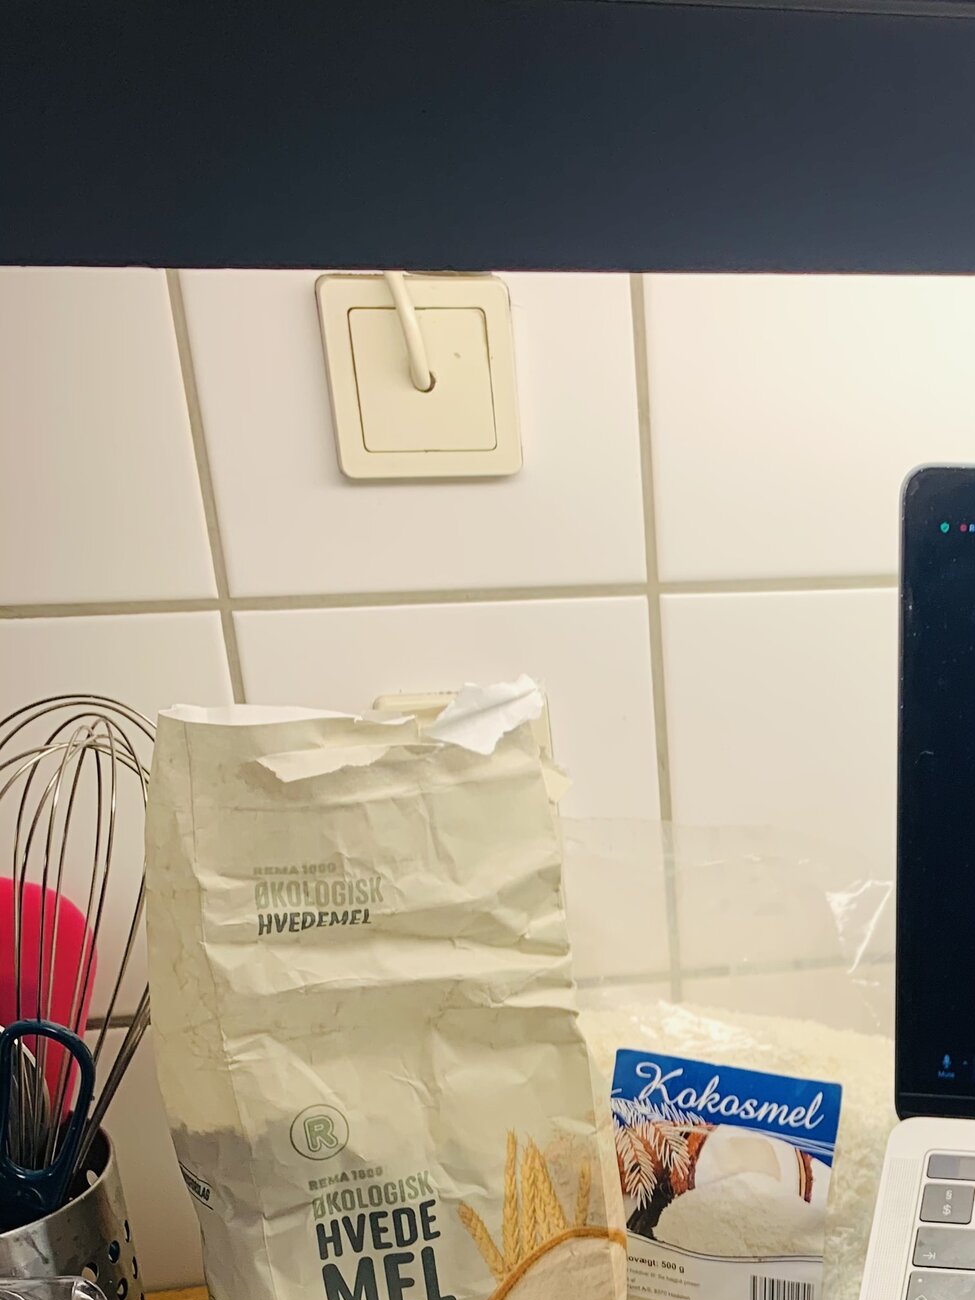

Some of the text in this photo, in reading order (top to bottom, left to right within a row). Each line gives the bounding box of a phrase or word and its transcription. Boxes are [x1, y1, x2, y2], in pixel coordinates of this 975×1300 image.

[253, 862, 337, 876] REMA 1000
[254, 876, 384, 910] ØKOLOGISK
[258, 908, 372, 936] HVEDEMEL
[635, 1061, 824, 1130] Kokosmel
[308, 1171, 351, 1191] REMA
[312, 1170, 434, 1222] ØKOLOGISK
[316, 1199, 441, 1260] HVEDE
[661, 1260, 677, 1271] 500
[678, 1265, 685, 1274] g
